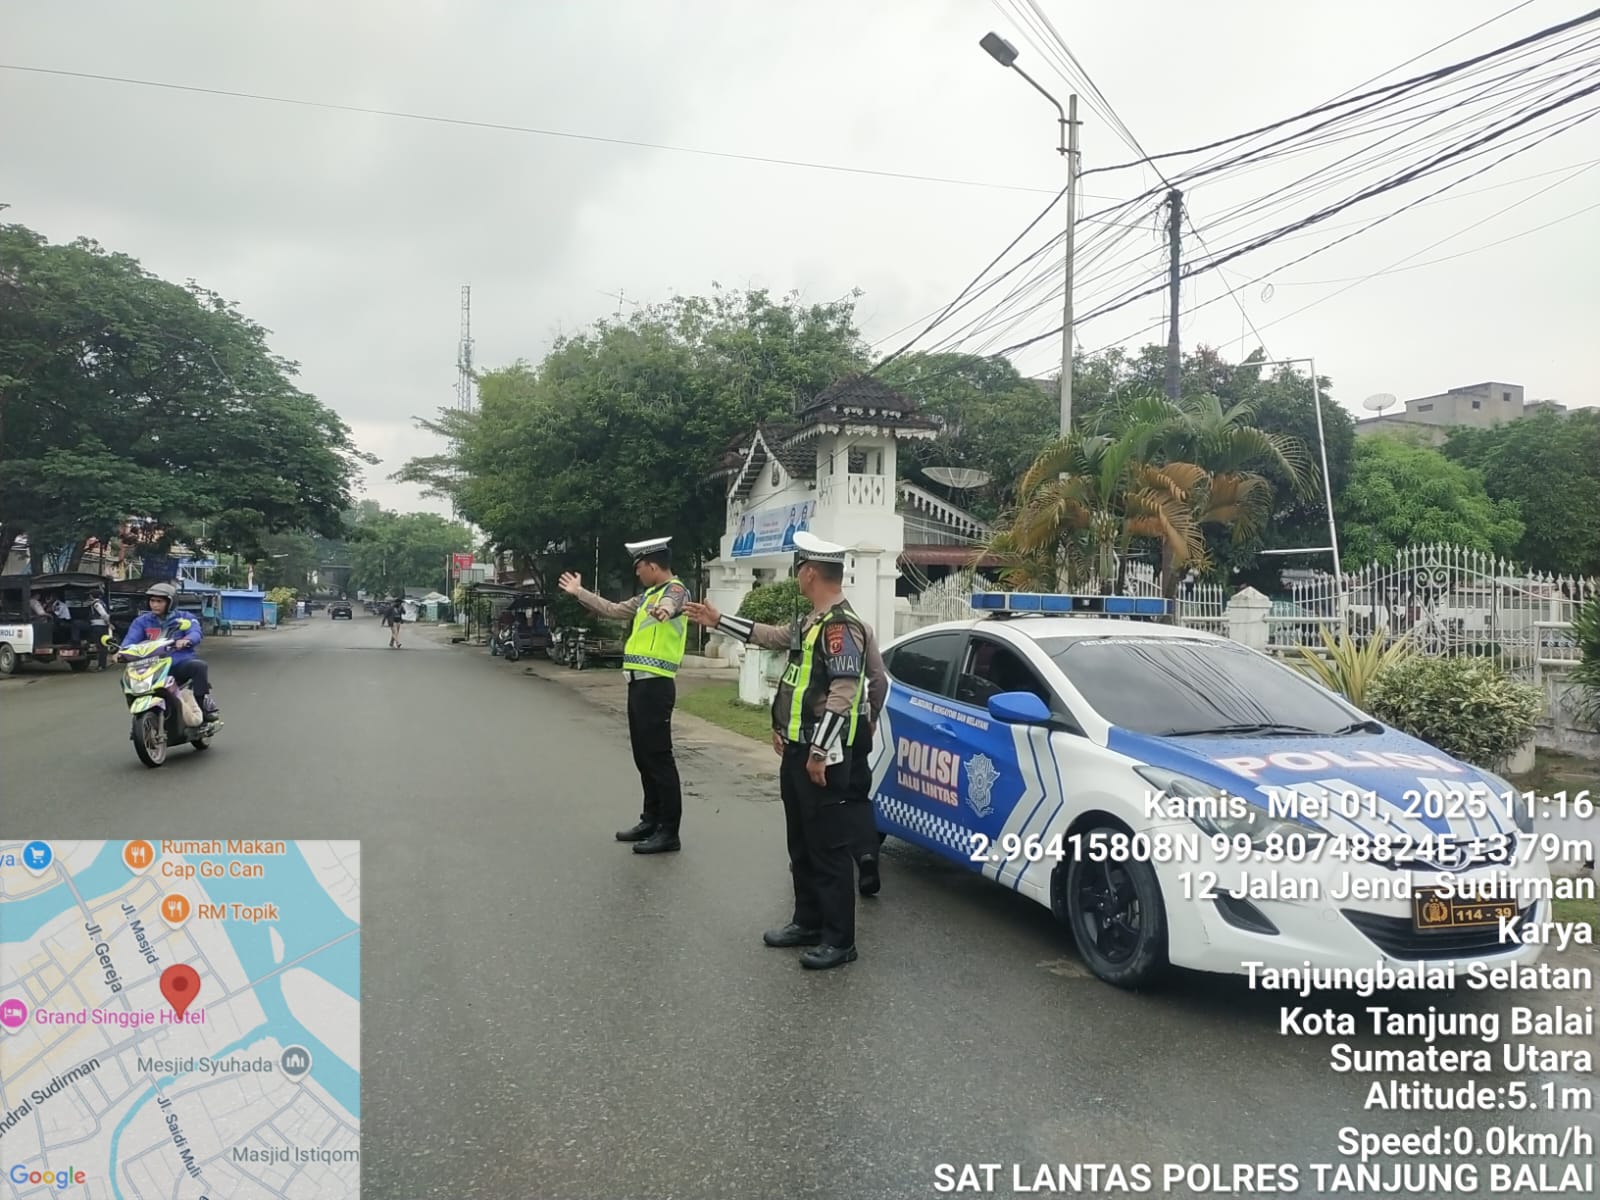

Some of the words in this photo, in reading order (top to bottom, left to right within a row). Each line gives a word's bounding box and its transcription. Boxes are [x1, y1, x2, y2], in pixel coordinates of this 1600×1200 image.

[897, 736, 960, 788] POLISI
[1213, 750, 1464, 778] POLISI
[898, 770, 920, 792] LALU
[921, 780, 959, 807] LINTAS
